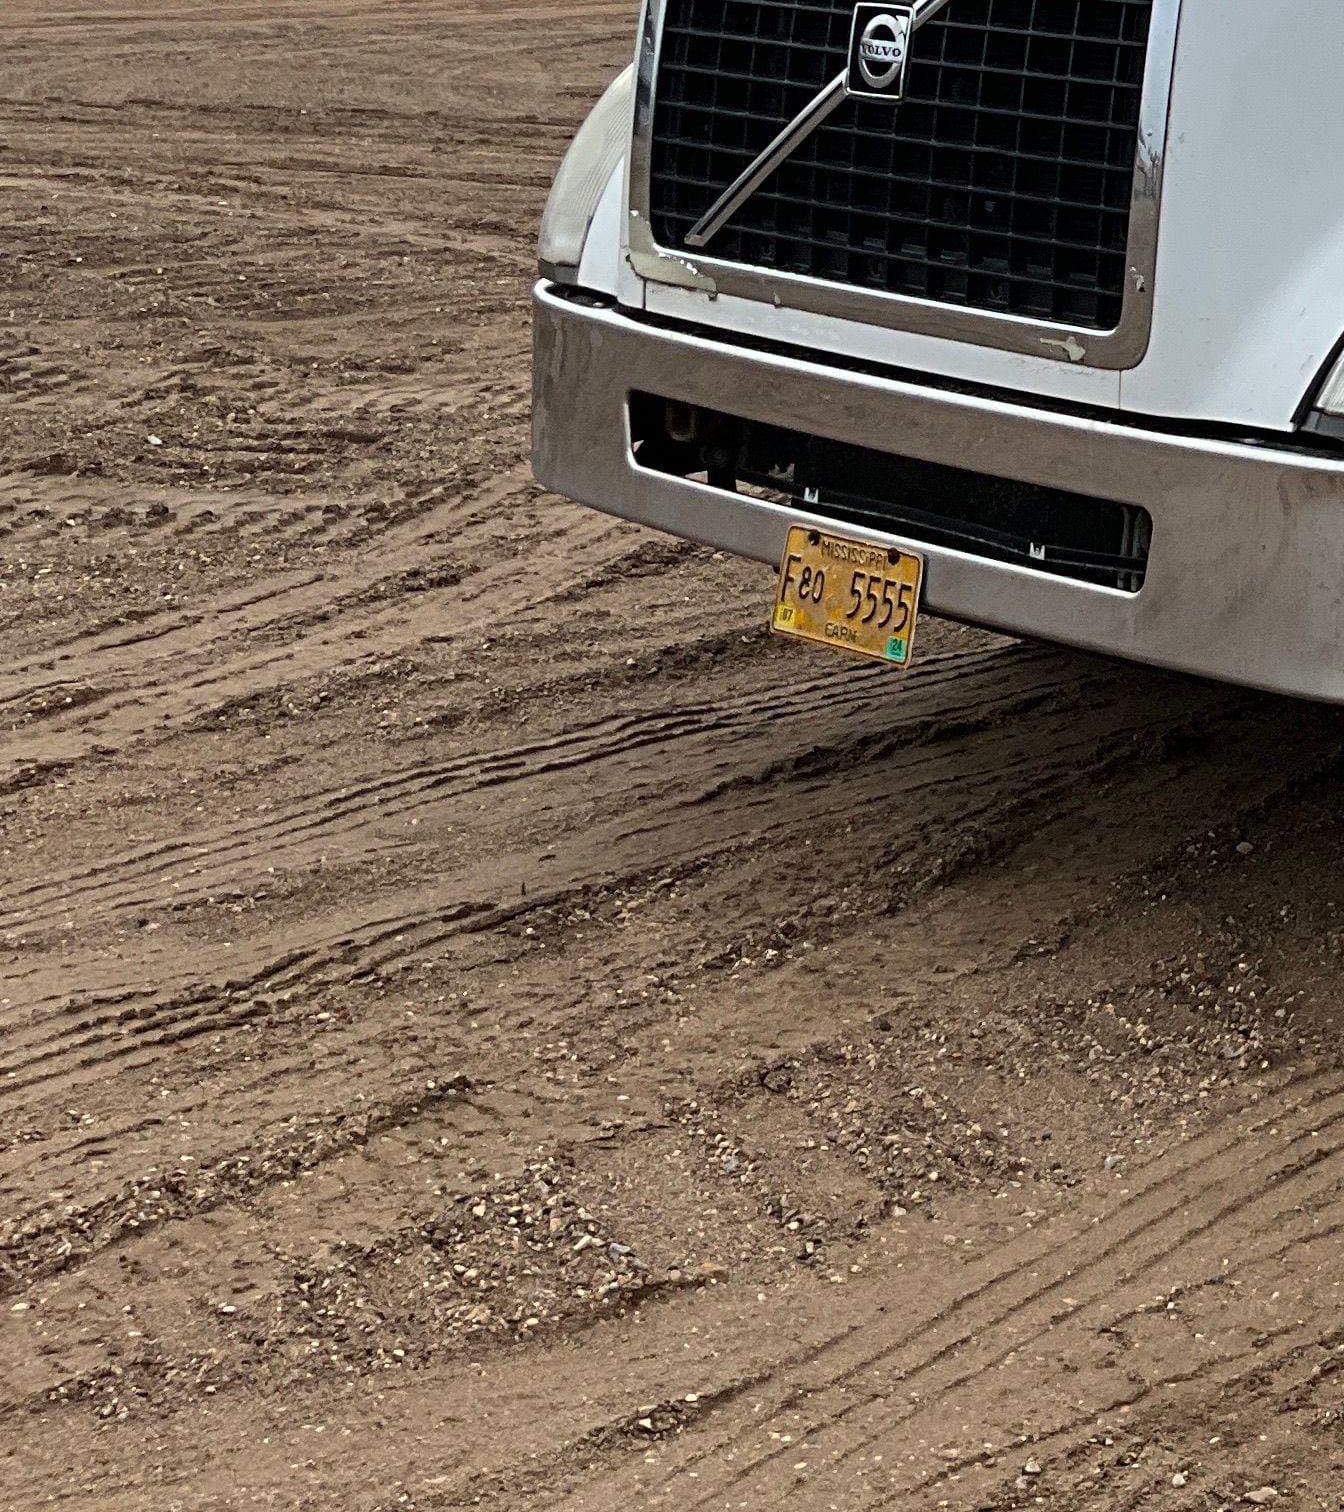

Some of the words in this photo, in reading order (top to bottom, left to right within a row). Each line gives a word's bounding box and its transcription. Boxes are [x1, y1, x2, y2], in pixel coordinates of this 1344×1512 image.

[861, 43, 902, 57] VOLVO
[821, 539, 887, 571] MISSISSIPPI
[846, 570, 912, 633] 5555
